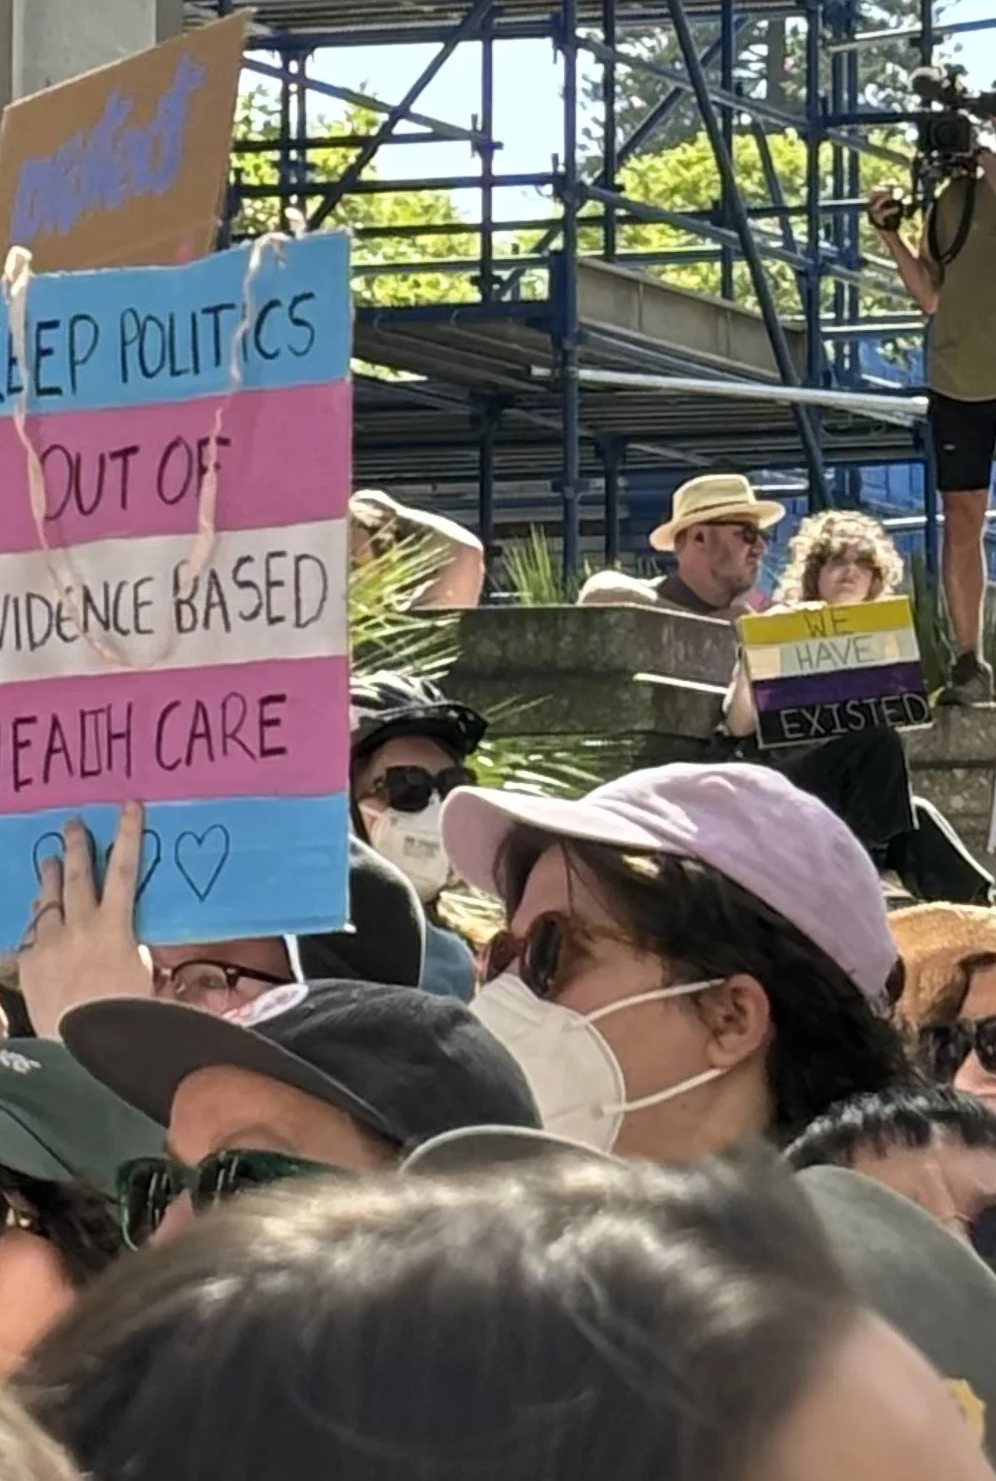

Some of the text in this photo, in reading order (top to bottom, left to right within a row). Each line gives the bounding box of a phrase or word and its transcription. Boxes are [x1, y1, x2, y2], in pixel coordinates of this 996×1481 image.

[40, 435, 232, 521] OUT OF
[172, 549, 330, 635] BASED
[804, 605, 855, 637] WE
[795, 634, 874, 671] HAVE
[154, 691, 290, 771] CARE
[780, 693, 929, 739] EXISTED
